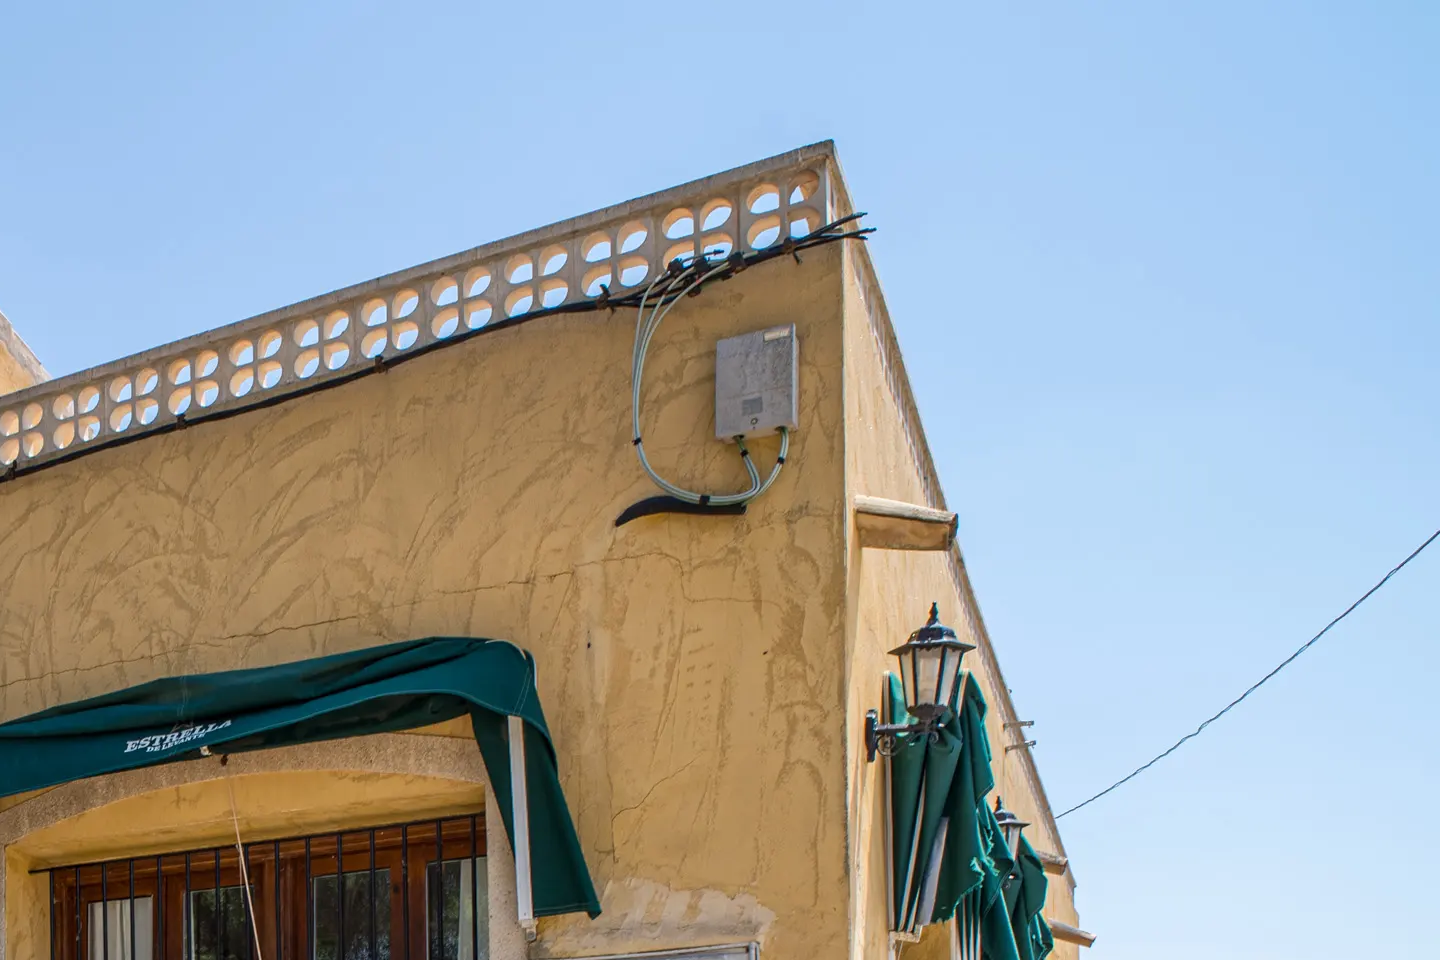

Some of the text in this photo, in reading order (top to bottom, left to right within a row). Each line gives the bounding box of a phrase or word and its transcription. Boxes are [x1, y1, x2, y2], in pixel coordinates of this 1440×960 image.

[123, 719, 232, 753] ESTRELLA
[146, 732, 206, 753] DE LEVANTE
